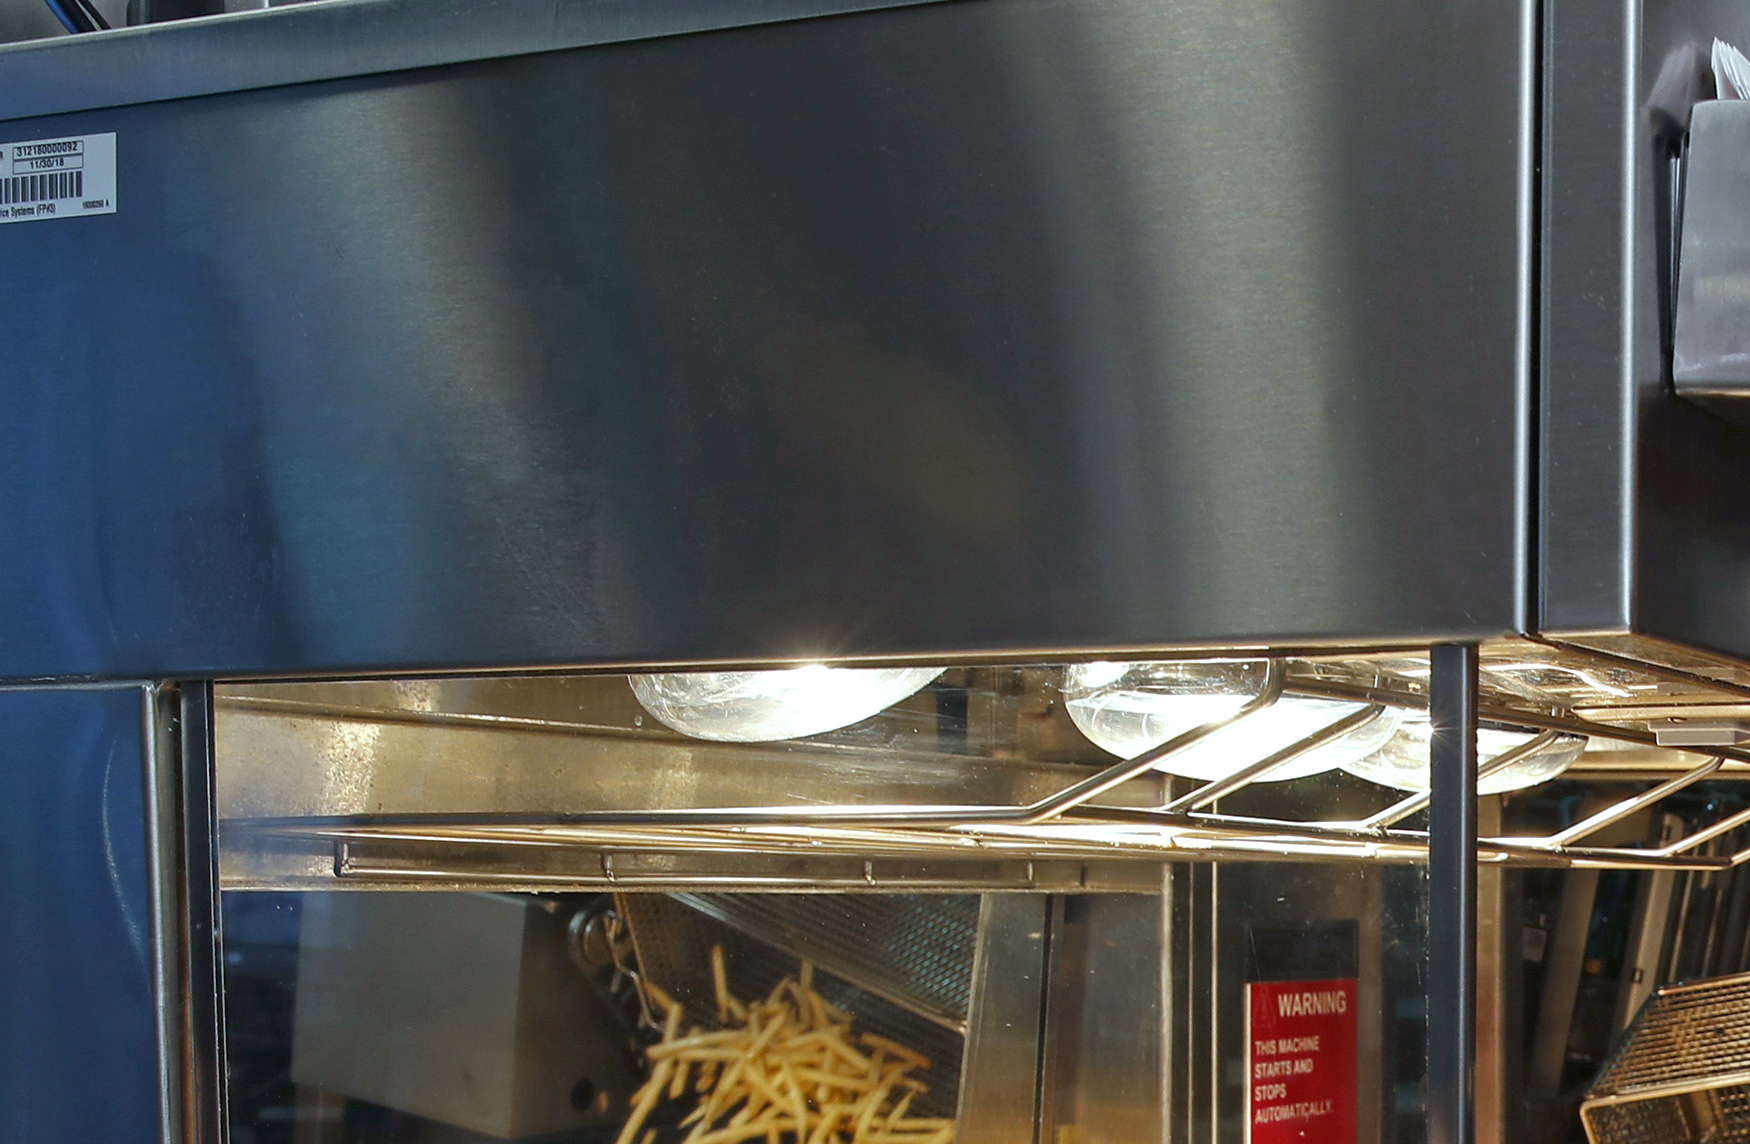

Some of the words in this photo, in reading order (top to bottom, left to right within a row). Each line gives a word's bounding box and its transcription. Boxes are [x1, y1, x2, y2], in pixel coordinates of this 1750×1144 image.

[30, 158, 64, 169] 11/30/18
[0, 208, 9, 217] ice
[11, 205, 34, 218] Systems
[1278, 990, 1347, 1017] WARNING
[1254, 1040, 1276, 1055] THIS
[1278, 1035, 1320, 1053] MACHINE
[1254, 1060, 1292, 1079] STARTS
[1293, 1058, 1314, 1074] AND
[1254, 1083, 1287, 1102] STOPS
